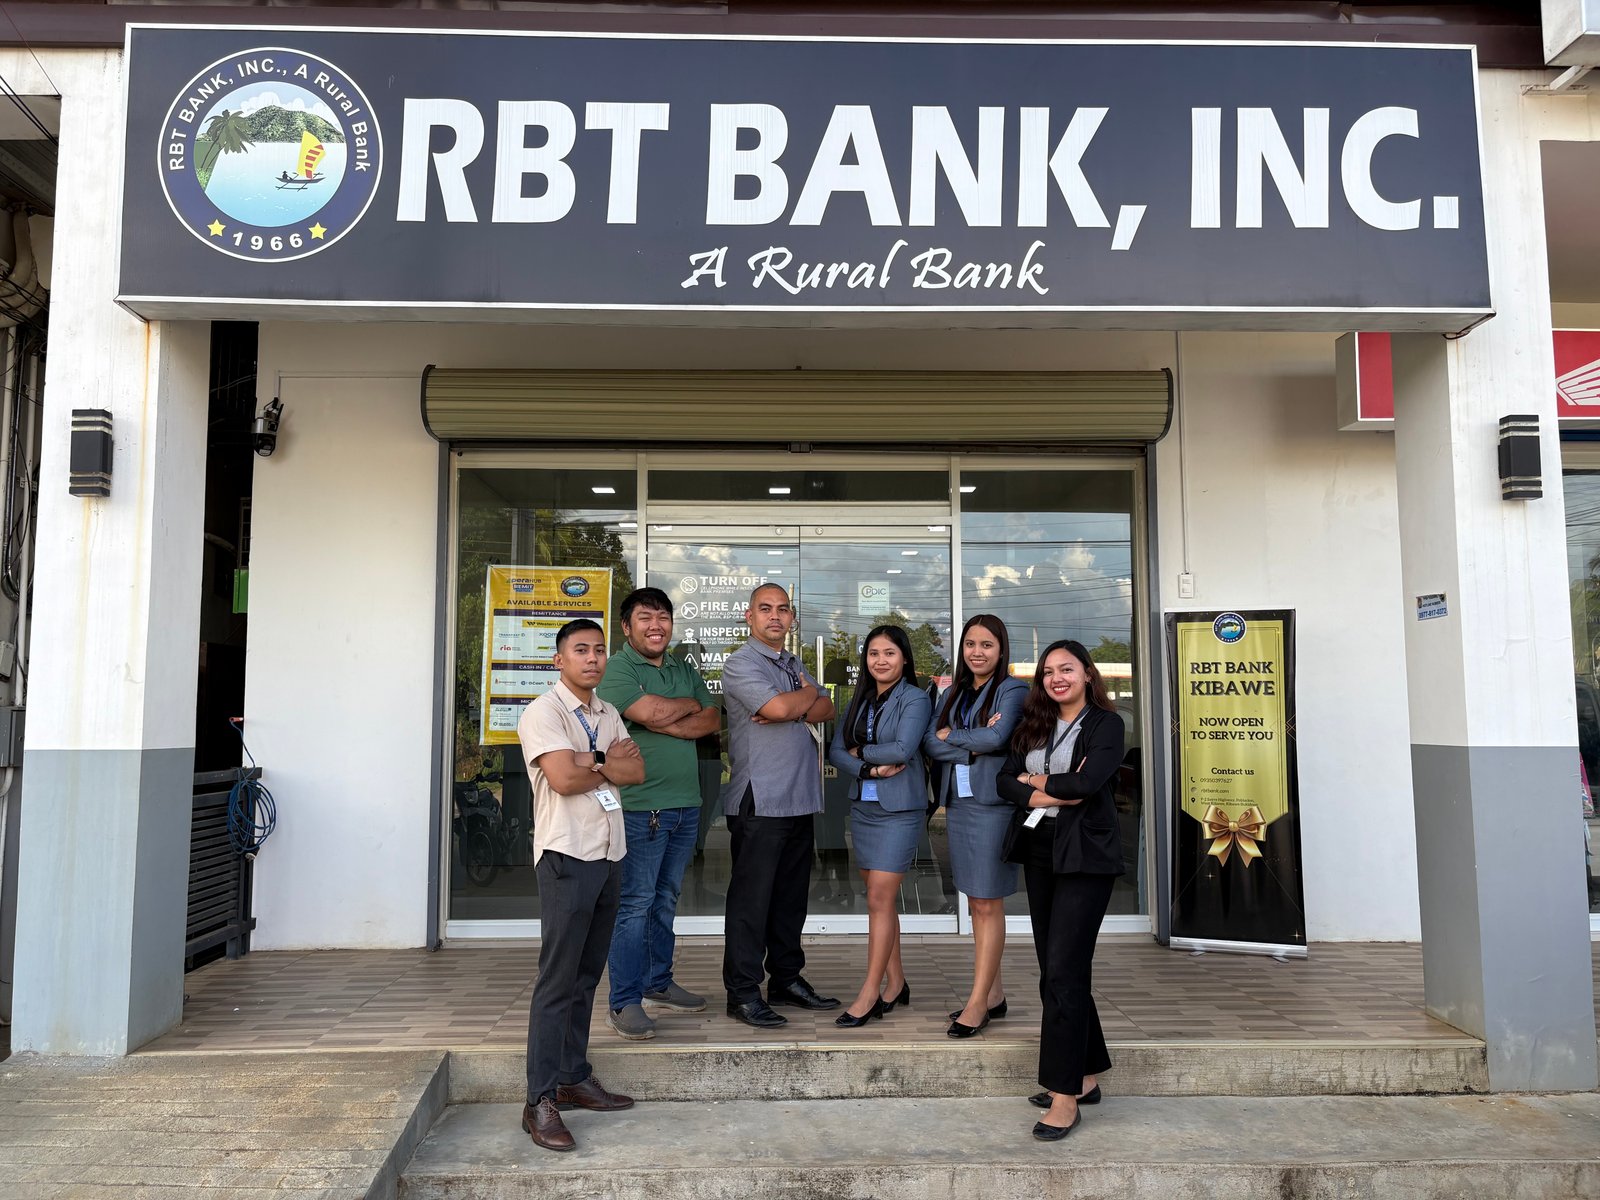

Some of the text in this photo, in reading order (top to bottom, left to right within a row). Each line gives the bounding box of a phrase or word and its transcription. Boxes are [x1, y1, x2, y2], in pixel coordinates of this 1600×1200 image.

[169, 58, 371, 173] RBT BANK, INC., A Rural Bank
[396, 97, 1460, 251] RBT BANK, INC.
[232, 231, 303, 250] 1966
[681, 240, 1049, 295] A Rural Bank
[700, 576, 768, 586] TURN OFF
[700, 602, 750, 611] FIRE AR
[700, 627, 750, 637] INSPECTI
[700, 653, 732, 662] WAR
[1190, 661, 1274, 674] RBT BANK
[1190, 680, 1275, 696] KIBAWE
[1199, 718, 1264, 727] NOW OPEN
[1190, 731, 1274, 740] TO SERVE YOU
[1211, 767, 1243, 775] Contact
